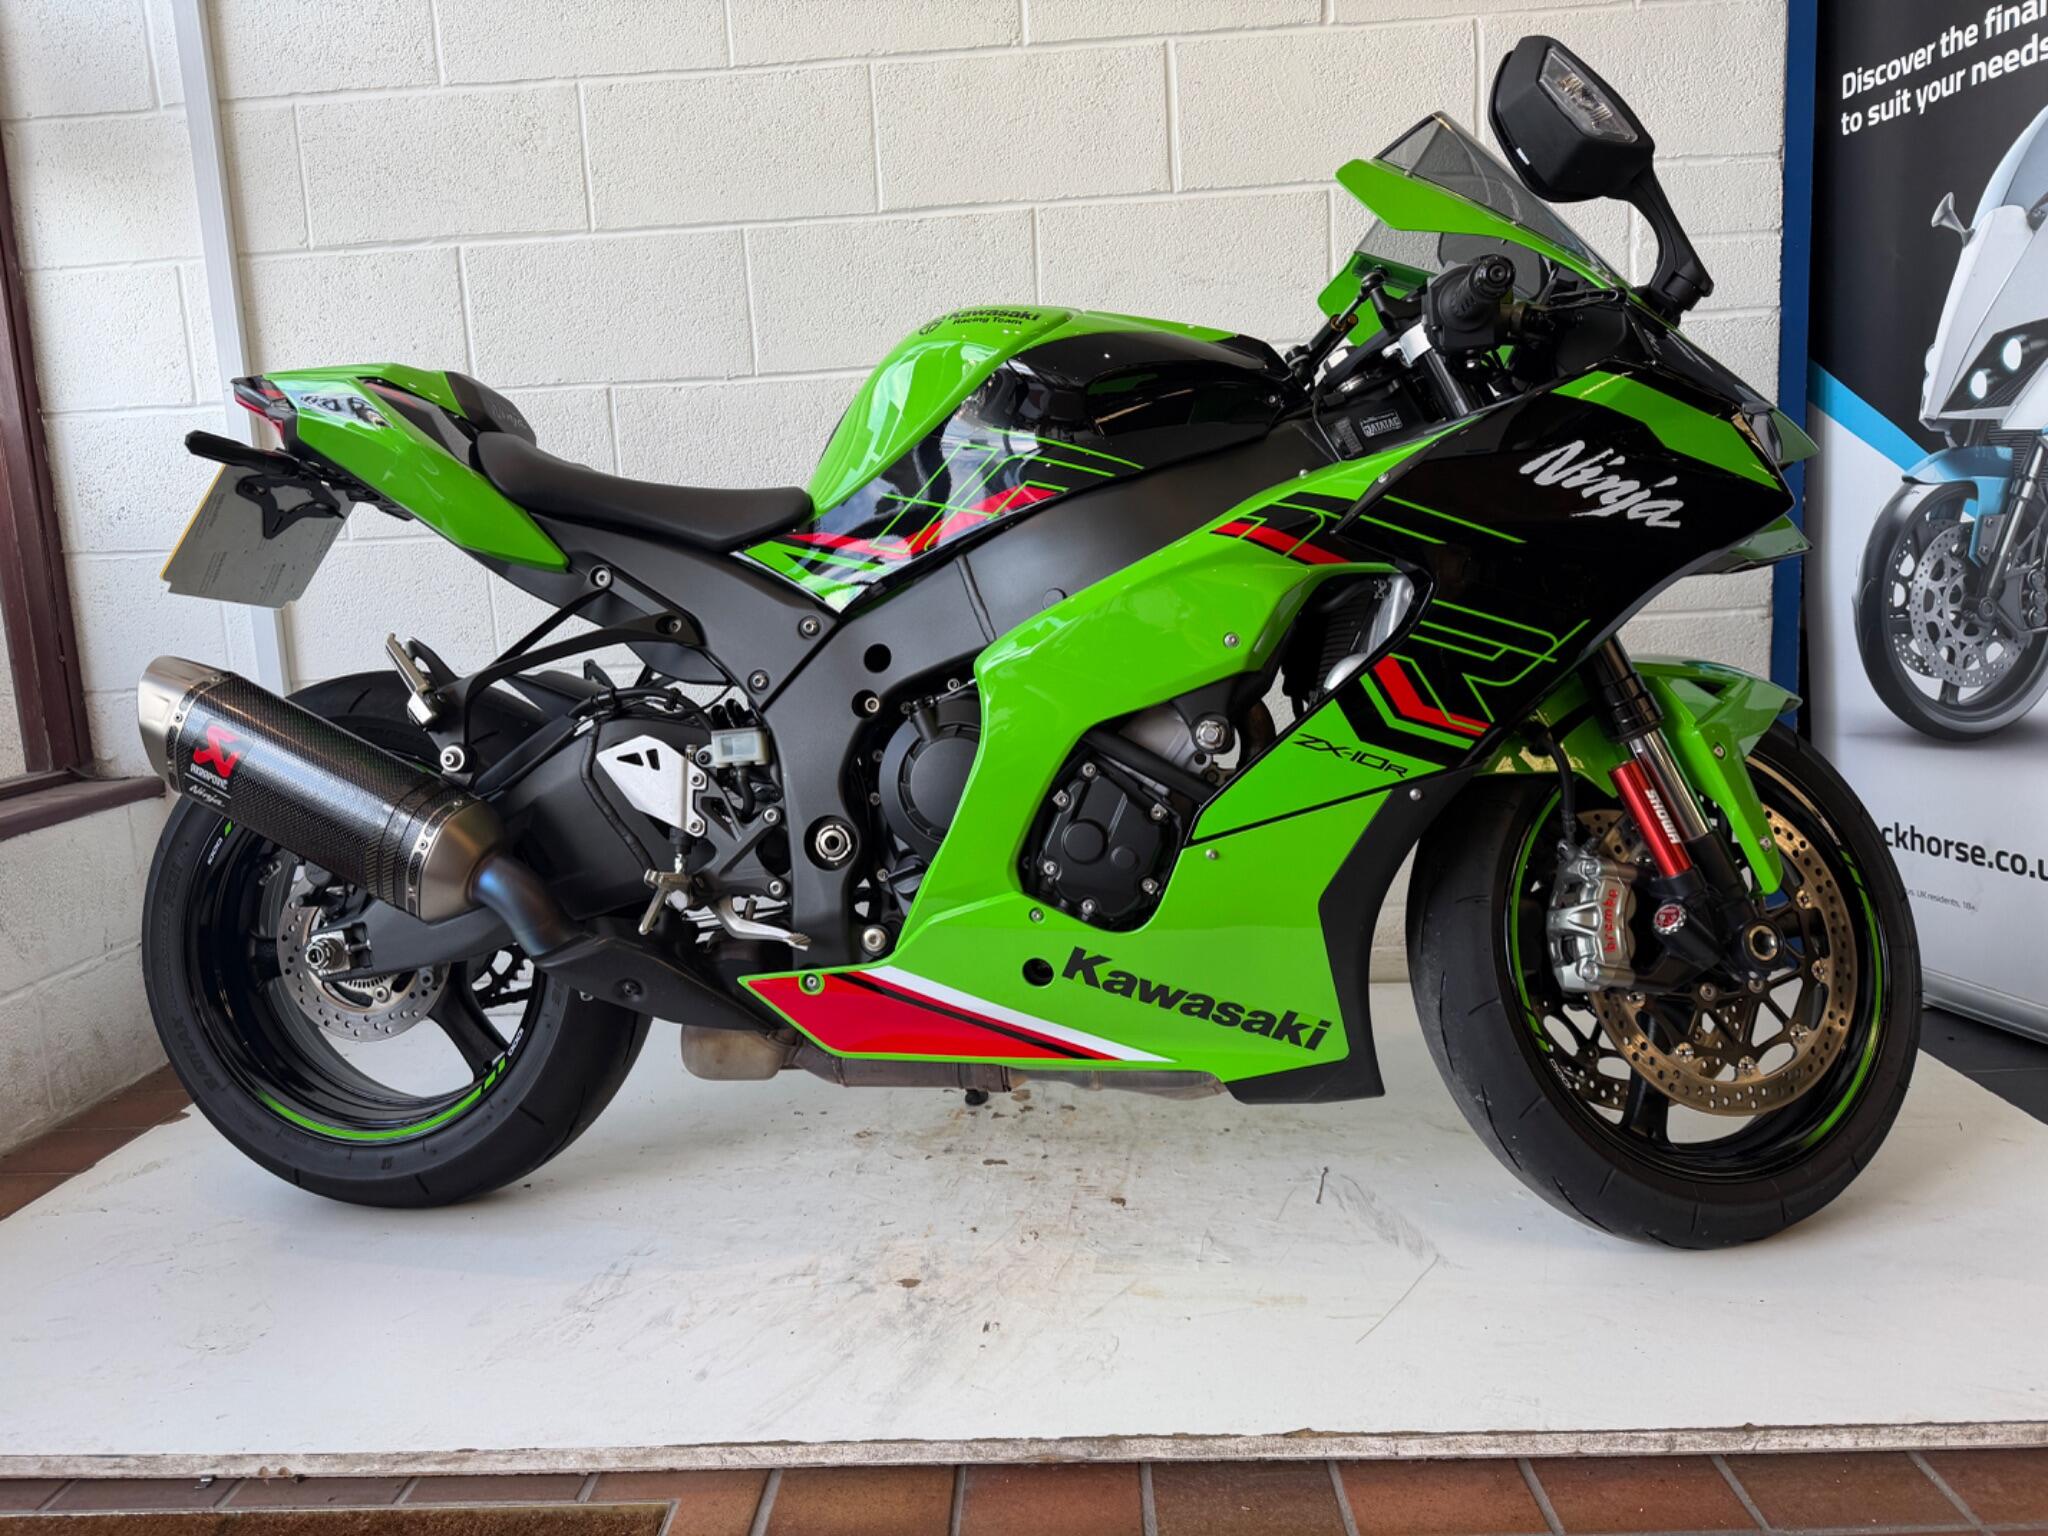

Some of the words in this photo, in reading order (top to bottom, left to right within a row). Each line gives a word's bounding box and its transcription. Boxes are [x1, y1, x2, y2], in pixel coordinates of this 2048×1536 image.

[1840, 111, 1863, 136] to
[1867, 88, 1911, 127] suit
[1915, 68, 1966, 116] your
[1971, 33, 2048, 87] needs
[1842, 41, 1936, 100] Discover
[1940, 23, 1979, 59] the
[952, 316, 990, 326] Racing
[992, 316, 1023, 326] Team
[1518, 439, 1685, 529] Ninja
[1292, 733, 1409, 778] ZX-10R
[188, 784, 226, 808] Ninja
[1644, 788, 1683, 845] SHOWA
[1602, 888, 1619, 953] brembo
[1061, 945, 1333, 1052] Kawasaki
